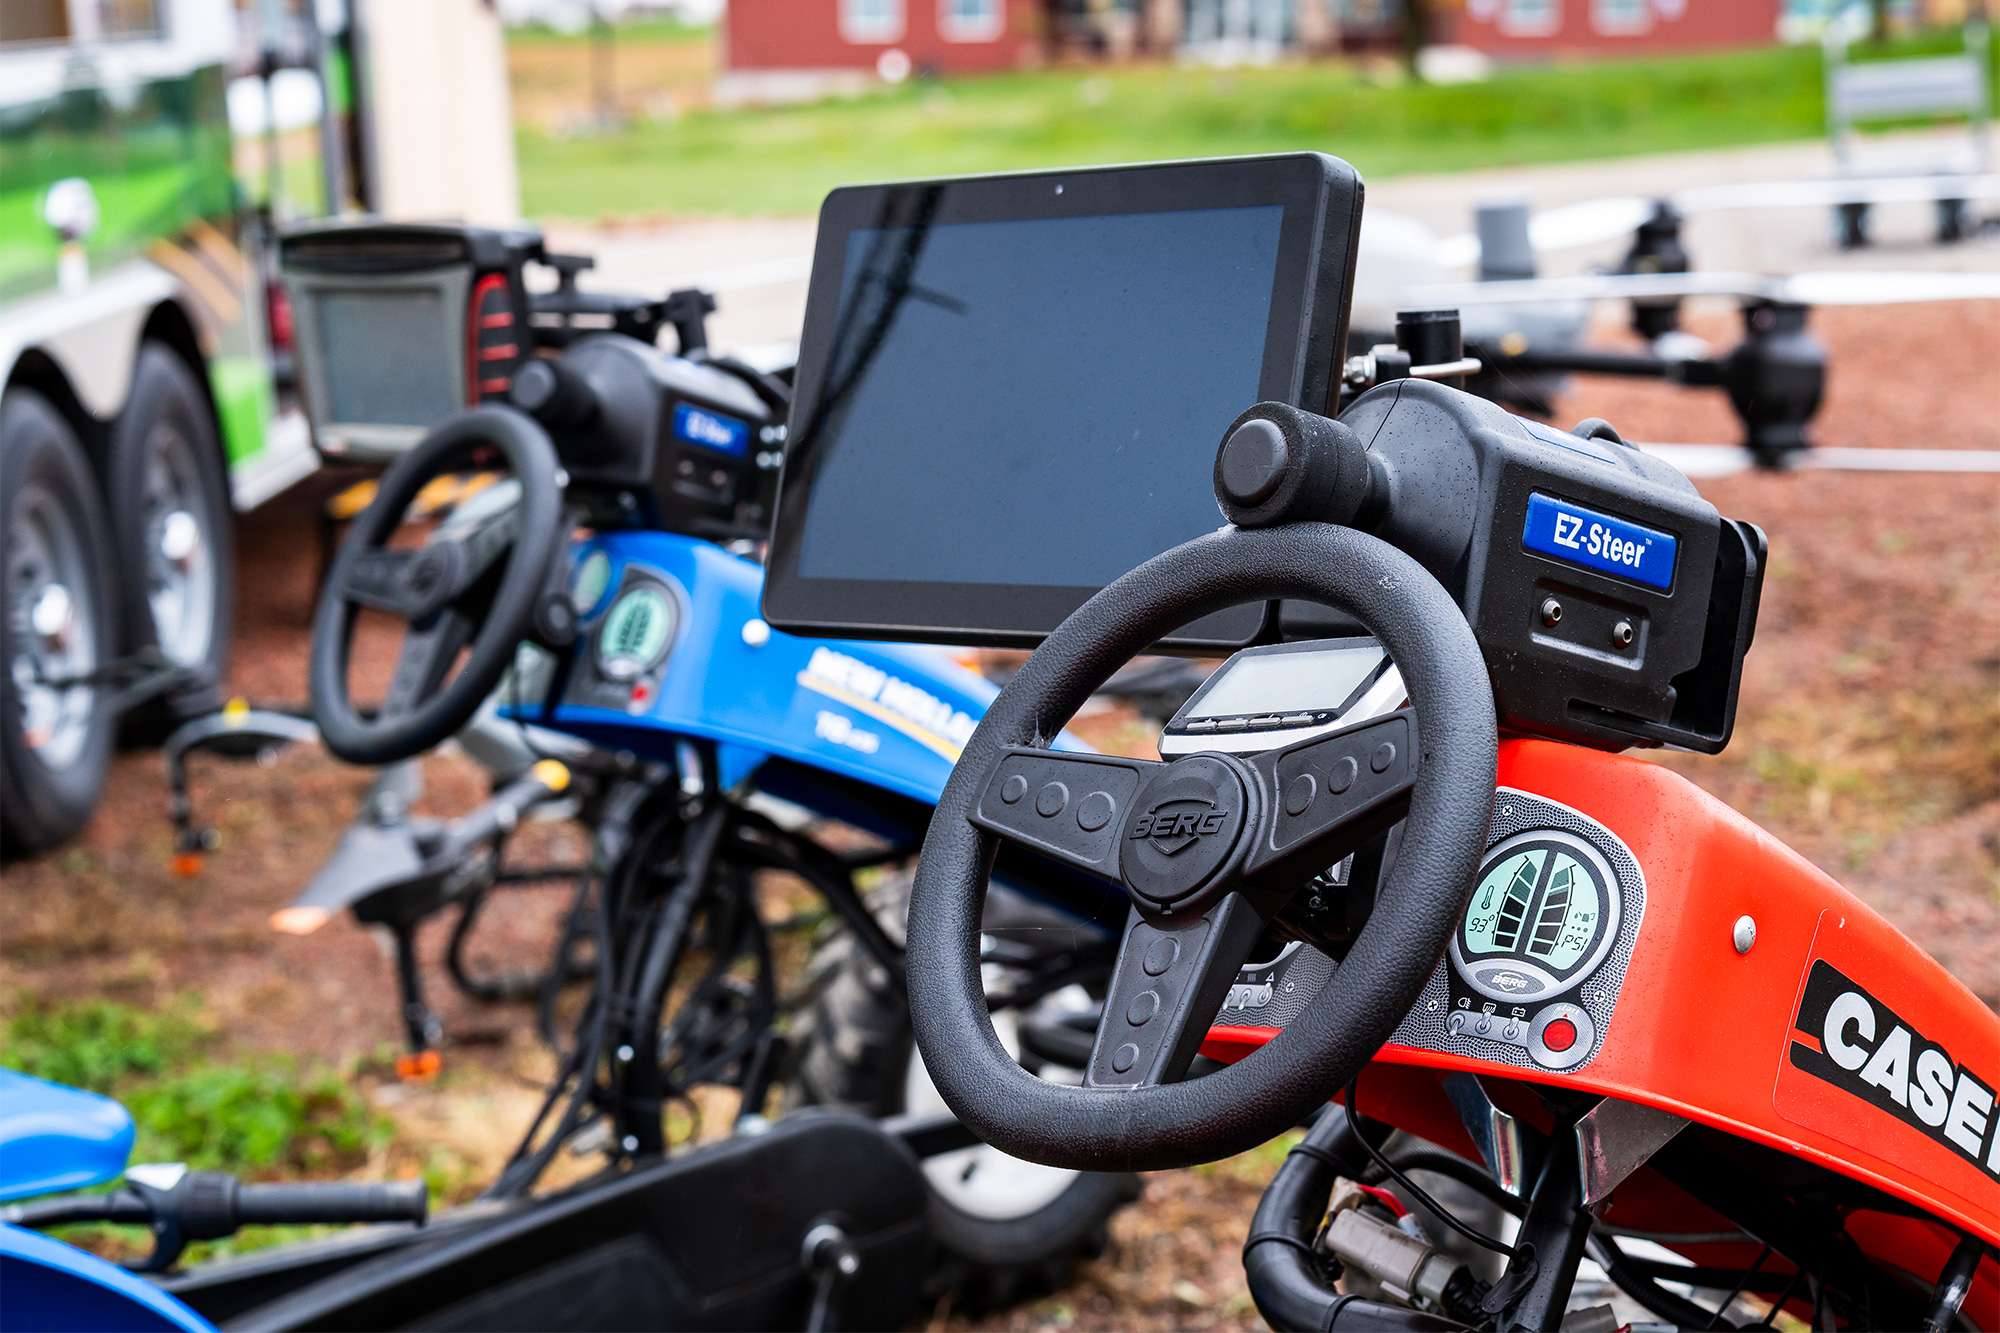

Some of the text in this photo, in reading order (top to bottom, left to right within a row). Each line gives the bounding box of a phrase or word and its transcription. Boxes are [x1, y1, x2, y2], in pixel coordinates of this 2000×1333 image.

[1129, 808, 1228, 841] BERG
[1560, 934, 1588, 952] PSI
[1491, 974, 1529, 989] BERG
